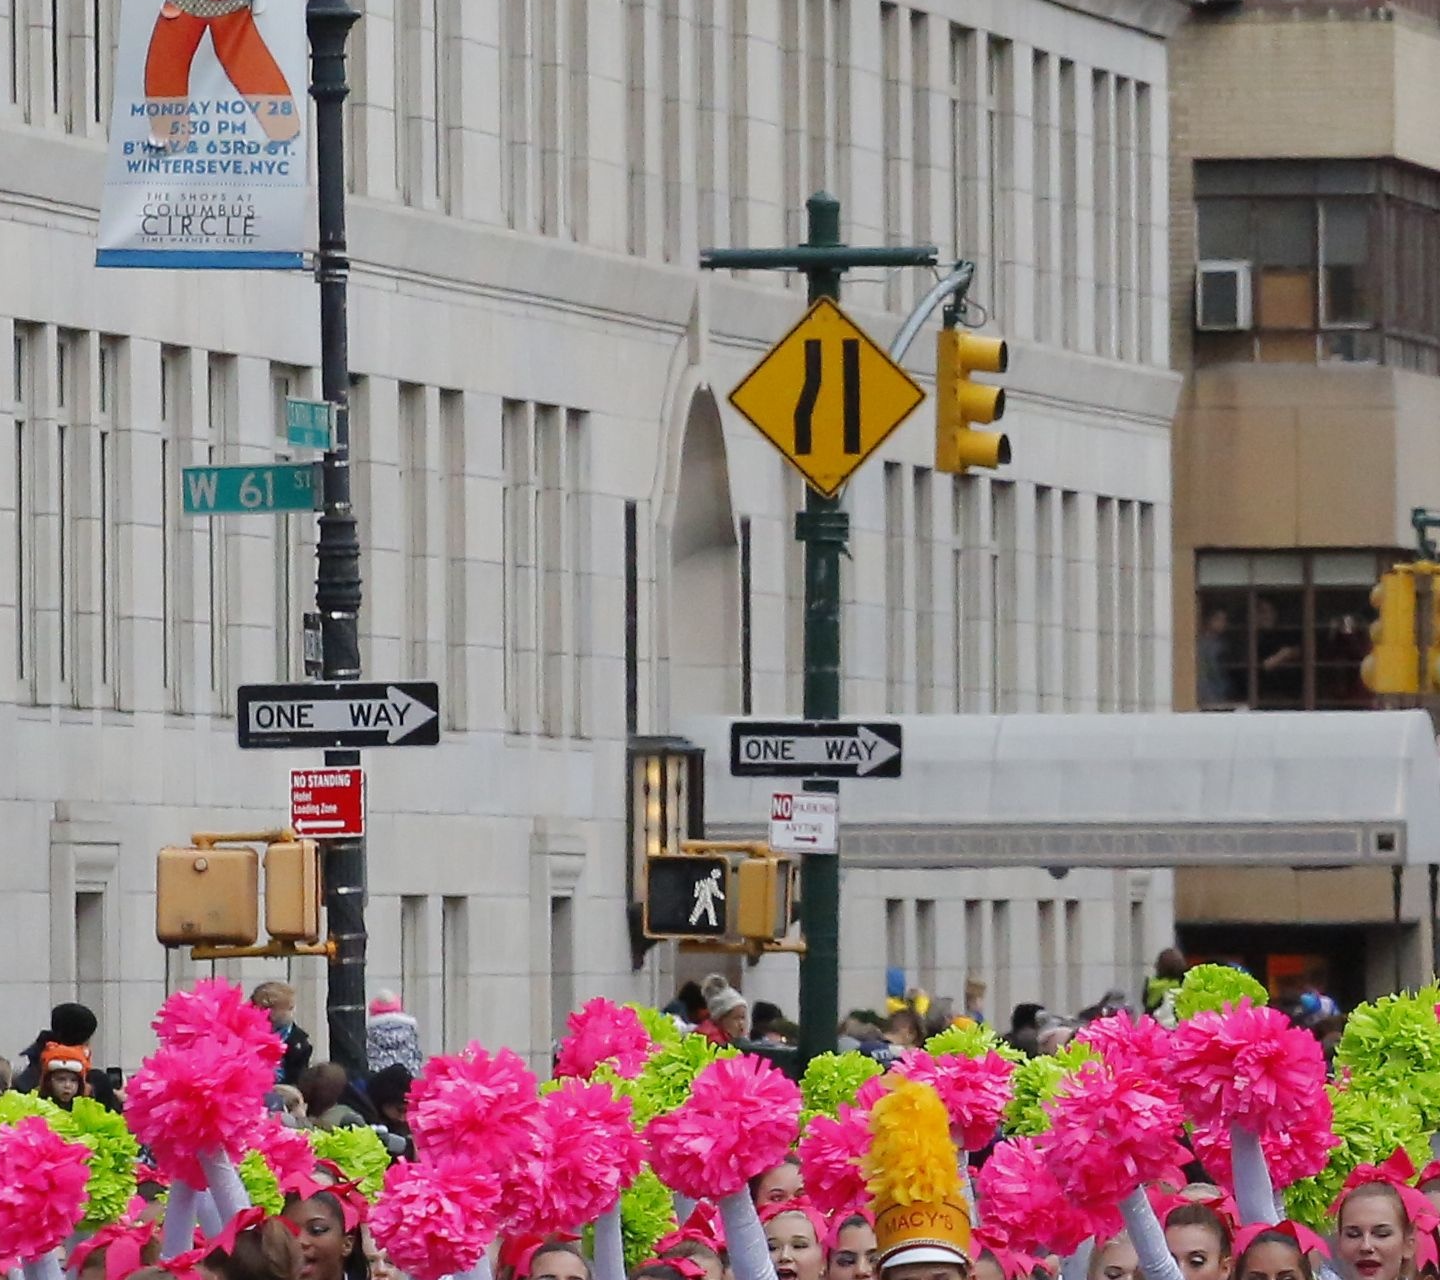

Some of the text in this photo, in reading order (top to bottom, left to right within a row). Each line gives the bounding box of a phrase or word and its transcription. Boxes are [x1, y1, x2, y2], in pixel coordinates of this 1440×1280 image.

[131, 100, 293, 117] MONDAY NOV 28
[170, 121, 247, 135] 5:30 PM
[186, 142, 198, 154] &
[206, 140, 260, 156] 63RD
[127, 160, 290, 175] WINTERSEVE.NYC
[147, 193, 253, 202] THE SHOPS AT
[143, 204, 256, 217] COLUMBUS
[141, 216, 256, 236] CIRCLE
[188, 471, 310, 509] W 61 ST
[256, 703, 412, 729] ONE WAY
[745, 740, 878, 761] ONE WAY
[293, 774, 351, 788] NO STANDING
[773, 797, 792, 819] NO
[886, 1211, 954, 1233] MACY'S
